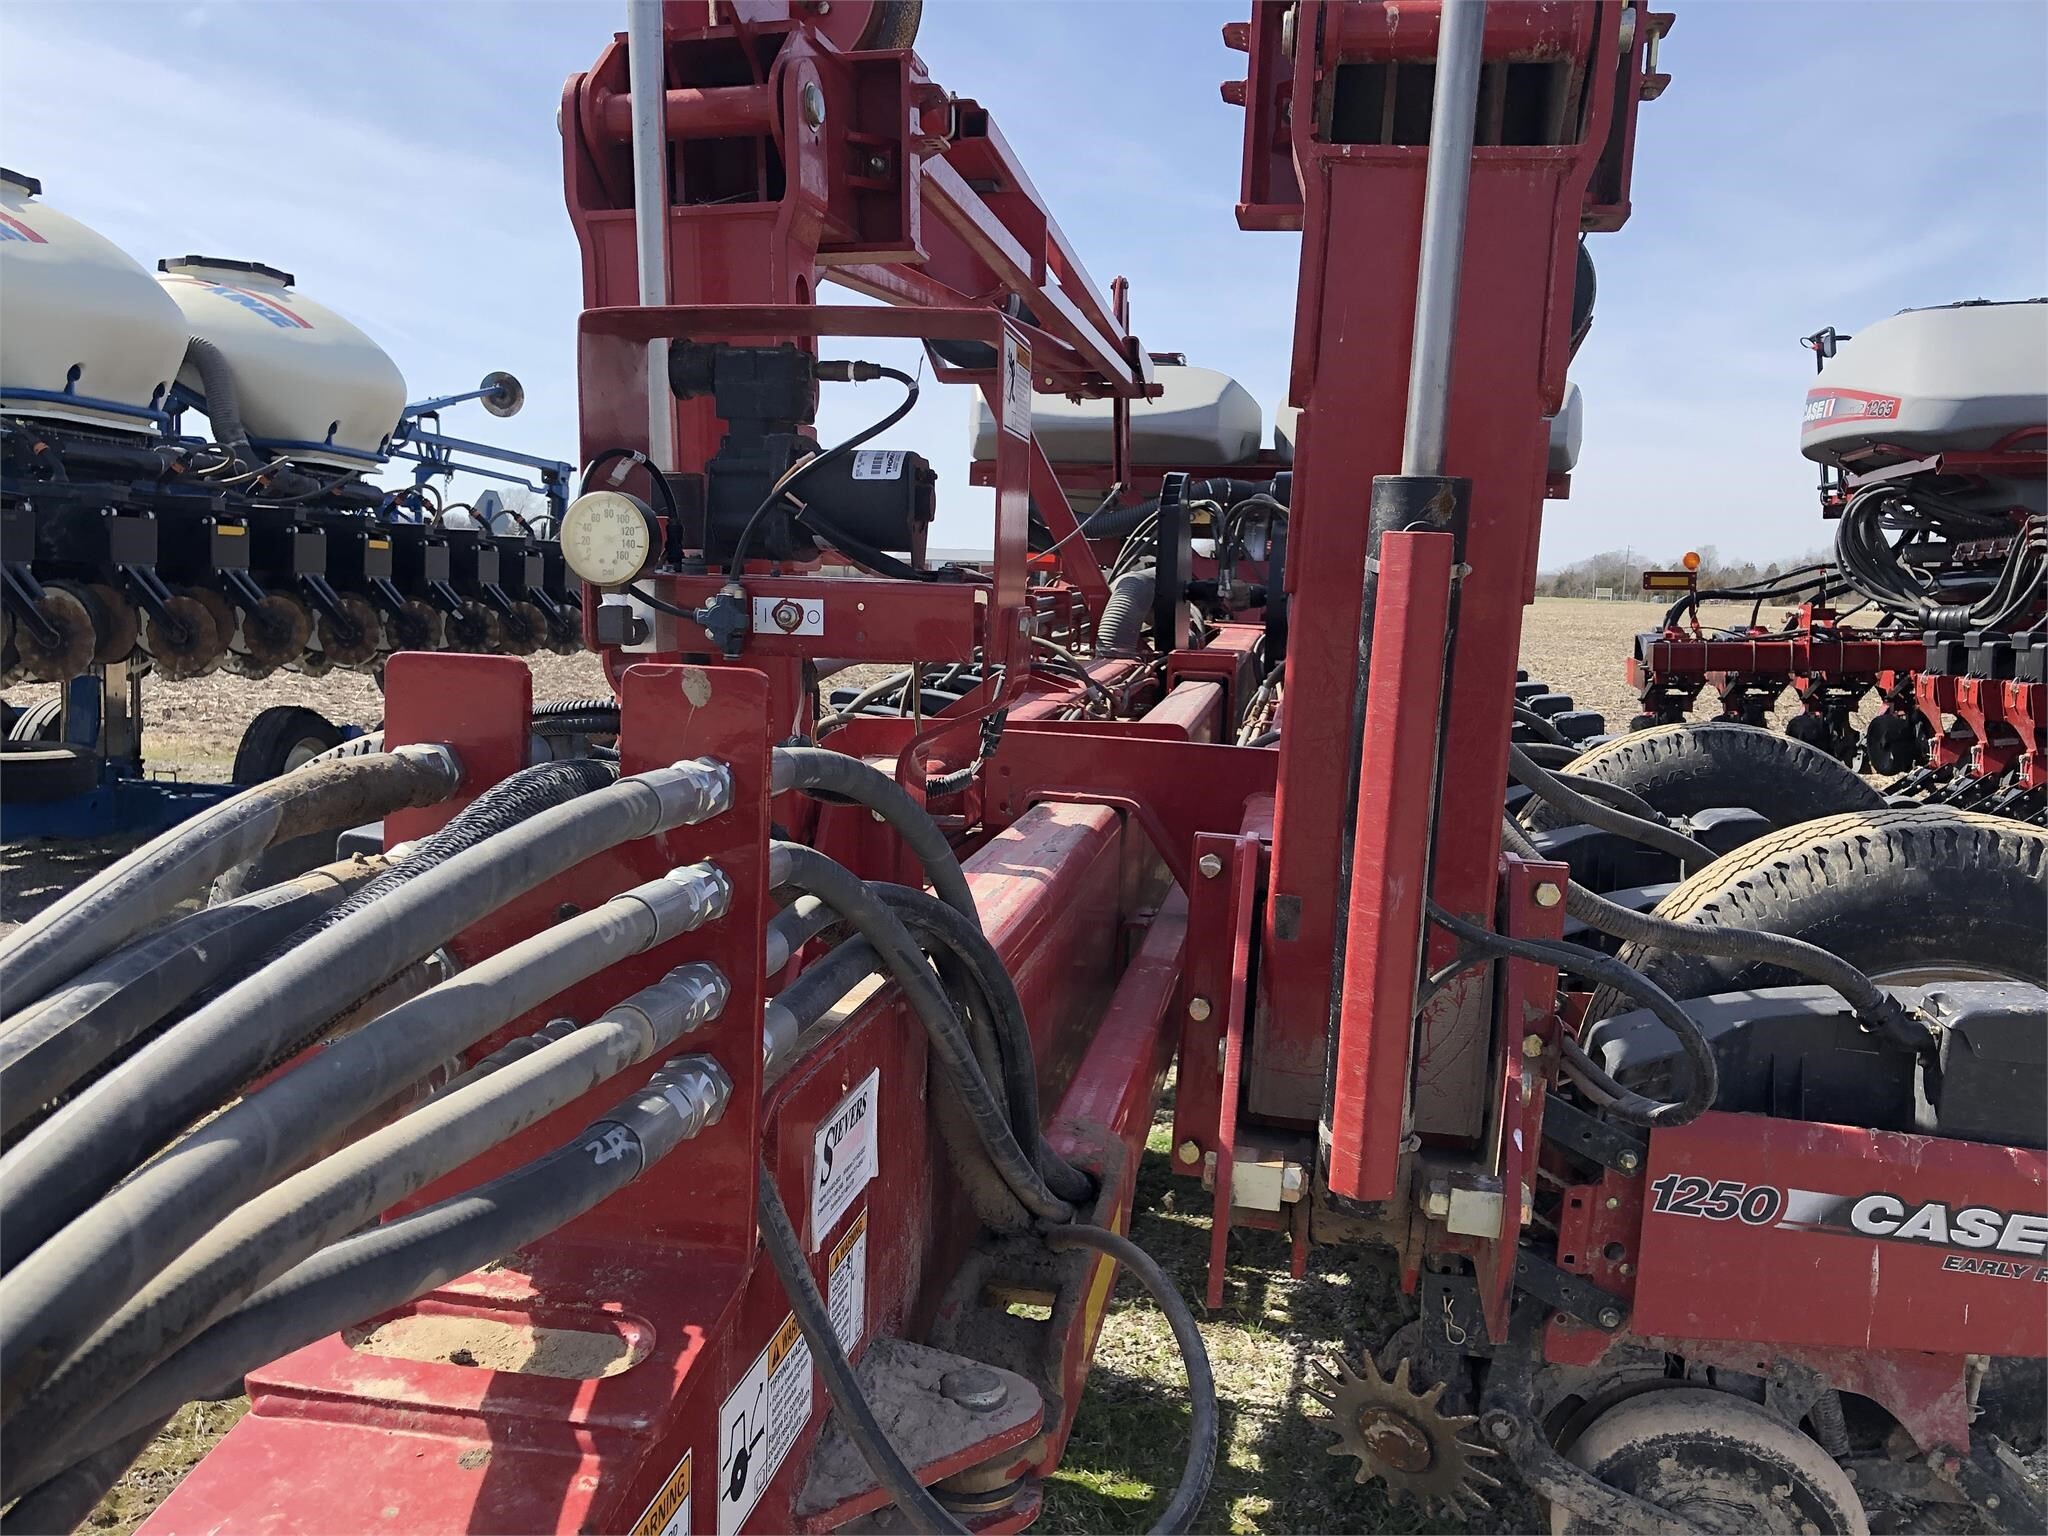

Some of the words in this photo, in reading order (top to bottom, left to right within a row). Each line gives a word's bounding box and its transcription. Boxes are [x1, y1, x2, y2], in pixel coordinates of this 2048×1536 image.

[1866, 400, 1894, 418] 1265
[617, 514, 630, 524] 100
[622, 526, 635, 536] 120
[581, 535, 591, 546] 20
[616, 551, 629, 560] 160
[819, 1091, 868, 1191] SIEVERS
[1650, 1173, 1781, 1226] 1250
[1851, 1195, 2048, 1256] CASE
[1942, 1254, 2032, 1280] EARLY
[769, 1357, 790, 1395] TIPPING
[640, 1473, 685, 1536] ARNING
